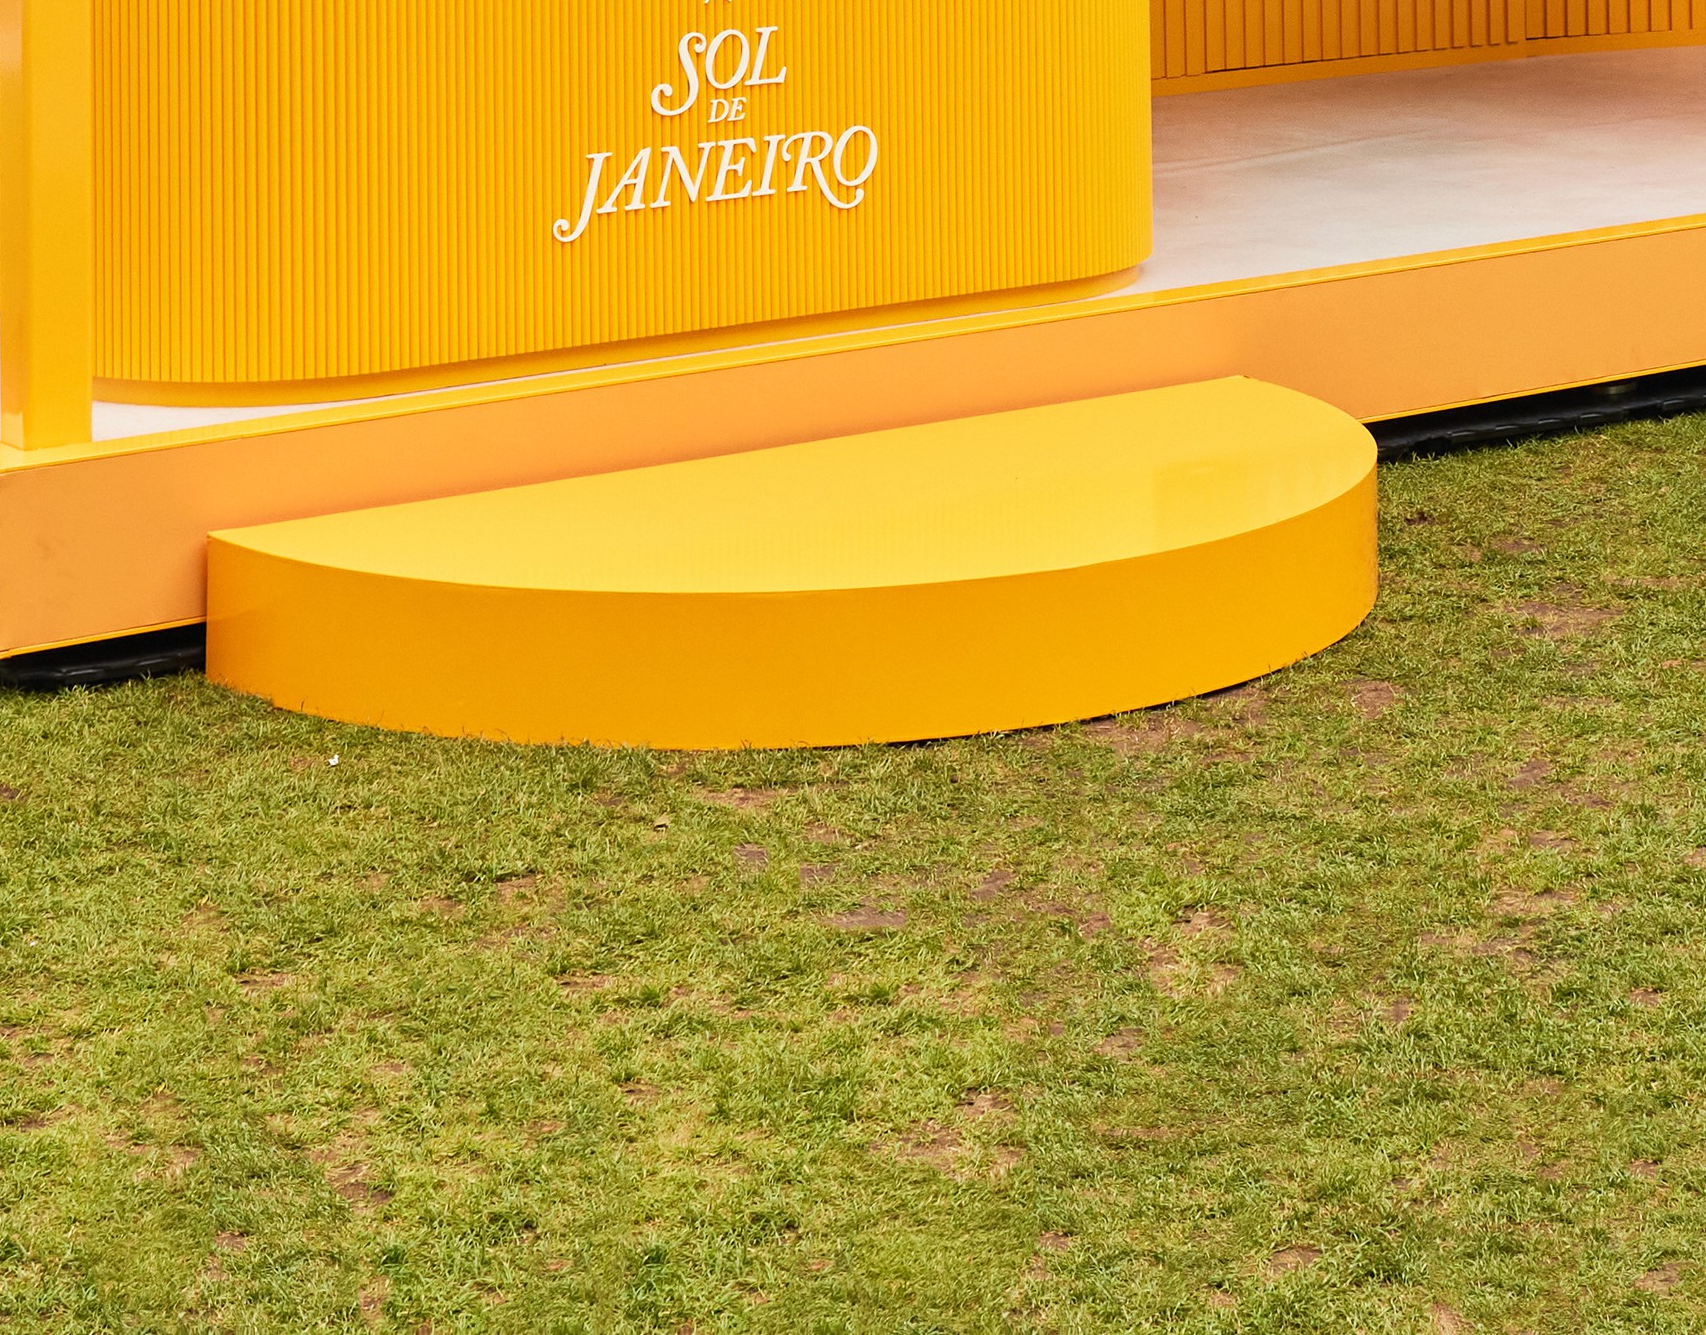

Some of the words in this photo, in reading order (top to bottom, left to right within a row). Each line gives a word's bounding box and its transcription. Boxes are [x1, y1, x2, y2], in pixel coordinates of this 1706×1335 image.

[650, 25, 787, 117] SOL
[707, 96, 748, 124] DE
[552, 124, 879, 244] JANEIRO
